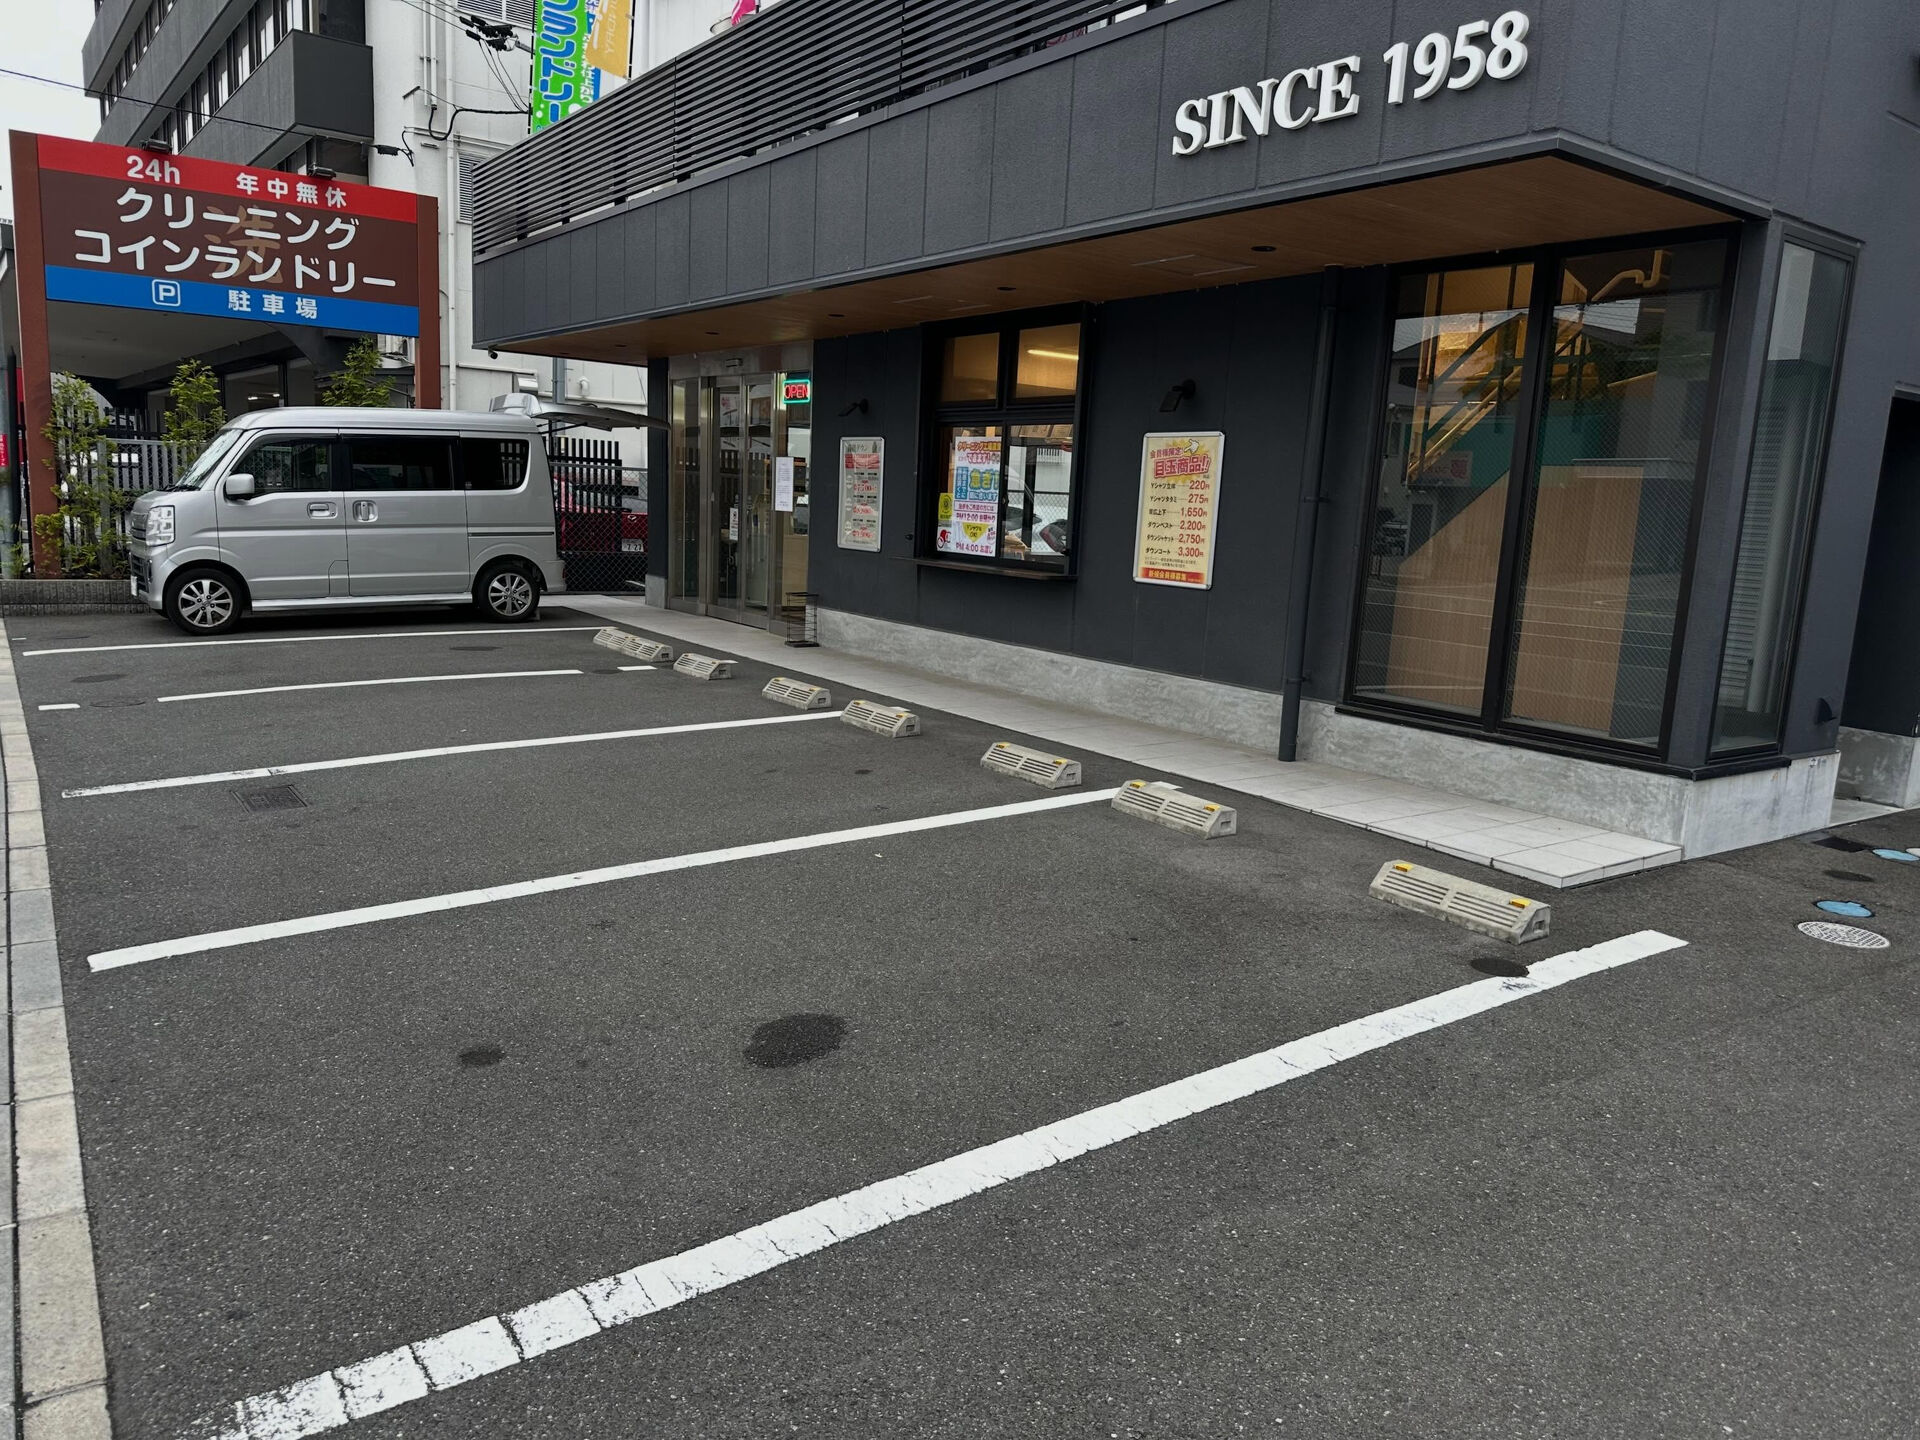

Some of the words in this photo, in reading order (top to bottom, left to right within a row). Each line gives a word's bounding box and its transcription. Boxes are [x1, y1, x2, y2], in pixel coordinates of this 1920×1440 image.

[1172, 55, 1361, 156] SINCE
[1383, 10, 1530, 105] 1958
[126, 154, 181, 186] 24h
[236, 171, 347, 208] 年中無休
[117, 187, 360, 250] クリーニング
[74, 228, 397, 293] コインランドリー
[227, 289, 319, 320] 駐車場
[784, 383, 809, 399] OPEN
